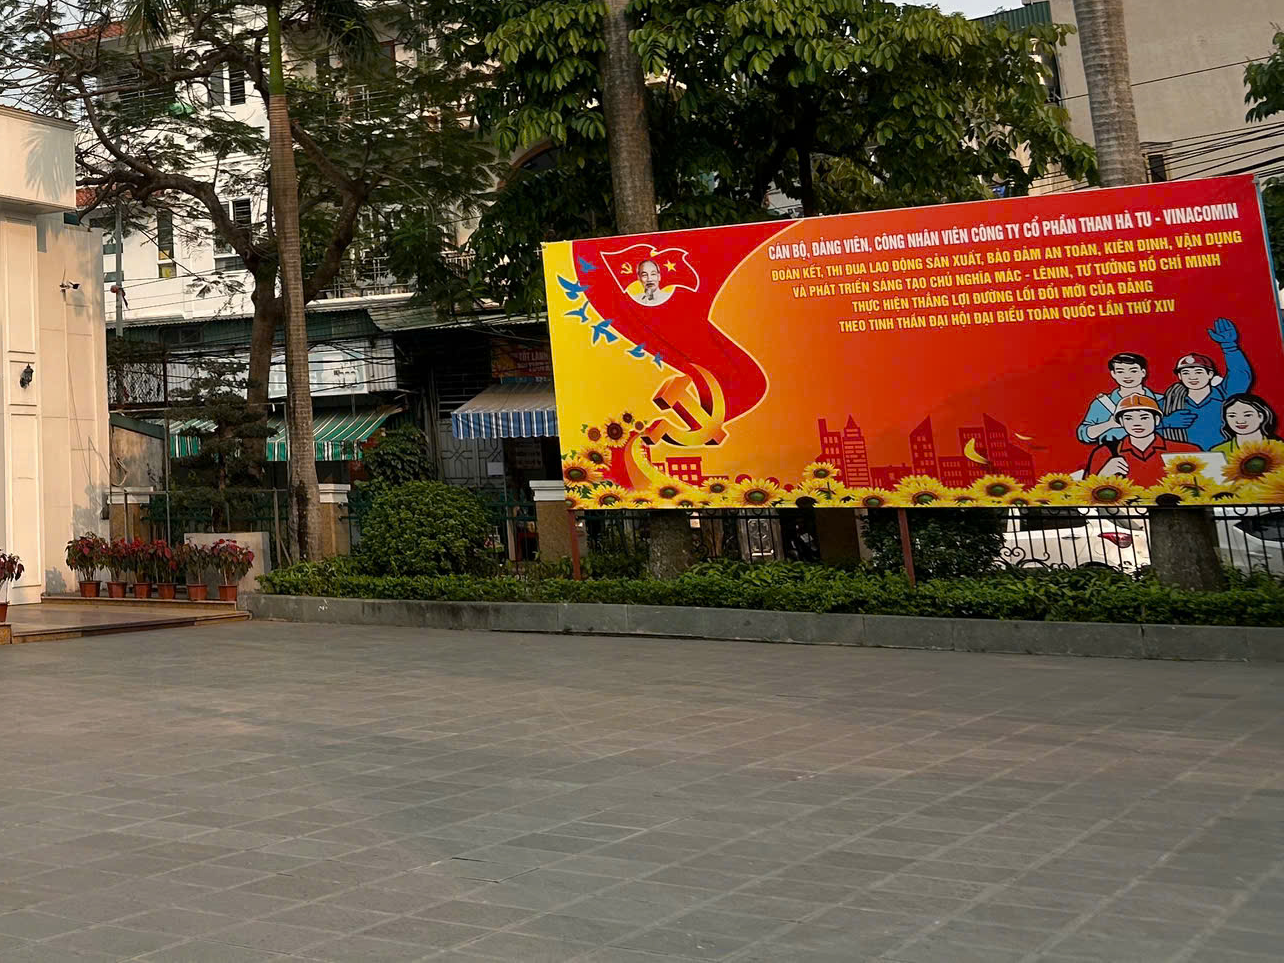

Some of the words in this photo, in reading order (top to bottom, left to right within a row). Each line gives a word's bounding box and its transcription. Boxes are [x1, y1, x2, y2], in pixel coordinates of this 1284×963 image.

[768, 242, 790, 260] CÁN
[793, 241, 810, 261] BỘ,
[812, 237, 842, 256] ĐẢNG
[845, 236, 872, 254] VIÊN,
[874, 233, 905, 251] CÔNG
[908, 229, 939, 248] NHÂN
[941, 226, 968, 245] VIÊN
[971, 224, 1004, 243] CÔNG
[1005, 224, 1020, 240] TY
[1023, 216, 1040, 238] CỔ
[1043, 214, 1077, 237] PHẦN
[1079, 214, 1113, 233] THAN
[1115, 210, 1133, 230] HÀ
[1135, 211, 1153, 227] TU
[1162, 202, 1239, 225] VINACOMIN
[771, 268, 800, 281] ĐOÀN
[803, 264, 824, 279] KẾT,
[826, 265, 842, 277] THI
[846, 262, 867, 275] ĐUA
[870, 260, 890, 274] LAO
[892, 258, 923, 273] ĐỘNG
[926, 253, 949, 269] SẢN
[953, 250, 984, 267] XUẤT,
[987, 247, 1011, 264] BẢO
[1014, 246, 1041, 262] ĐẢM
[1045, 246, 1062, 259] AN
[1064, 242, 1101, 257] TOÀN,
[1104, 239, 1135, 255] KIÊN
[1137, 237, 1173, 254] ĐỊNH,
[1175, 233, 1203, 251] VẬN
[1206, 230, 1243, 248] DỤNG
[793, 284, 807, 299] VÀ
[809, 282, 836, 297] PHÁT
[838, 278, 870, 294] TRIỂN
[873, 276, 903, 292] SÁNG
[905, 277, 927, 292] TẠO
[929, 272, 952, 287] CHỦ
[956, 270, 992, 286] NGHĨA
[995, 268, 1022, 283] MÁC
[1033, 266, 1074, 280] LÊNIN,
[1076, 263, 1092, 277] TƯ
[1094, 258, 1136, 276] TƯỞNG
[1160, 254, 1182, 271] CHÍ
[1185, 253, 1221, 269] MINH
[839, 319, 866, 333] THEO
[868, 318, 894, 331] TINH
[929, 314, 948, 329] ĐẠI
[951, 311, 971, 328] HỘI
[974, 311, 994, 326] ĐẠI
[997, 305, 1024, 323] BIỂU
[1027, 306, 1060, 321] TOÀN
[1063, 300, 1096, 320] QUỐC
[1098, 300, 1124, 317] LẦN
[1126, 299, 1151, 314] THỨ
[1155, 299, 1175, 312] XIV
[852, 299, 880, 314] THỰC
[883, 297, 909, 312] HIỆN
[912, 292, 949, 309] THẮNG
[952, 290, 970, 308] LỢI
[973, 288, 1013, 304] ĐƯỜNG
[1017, 284, 1035, 302] LỐI
[1038, 282, 1059, 300] ĐỔI
[1062, 283, 1087, 298] MỚI
[1090, 280, 1115, 297] CỦA
[1118, 278, 1154, 295] ĐẢNG
